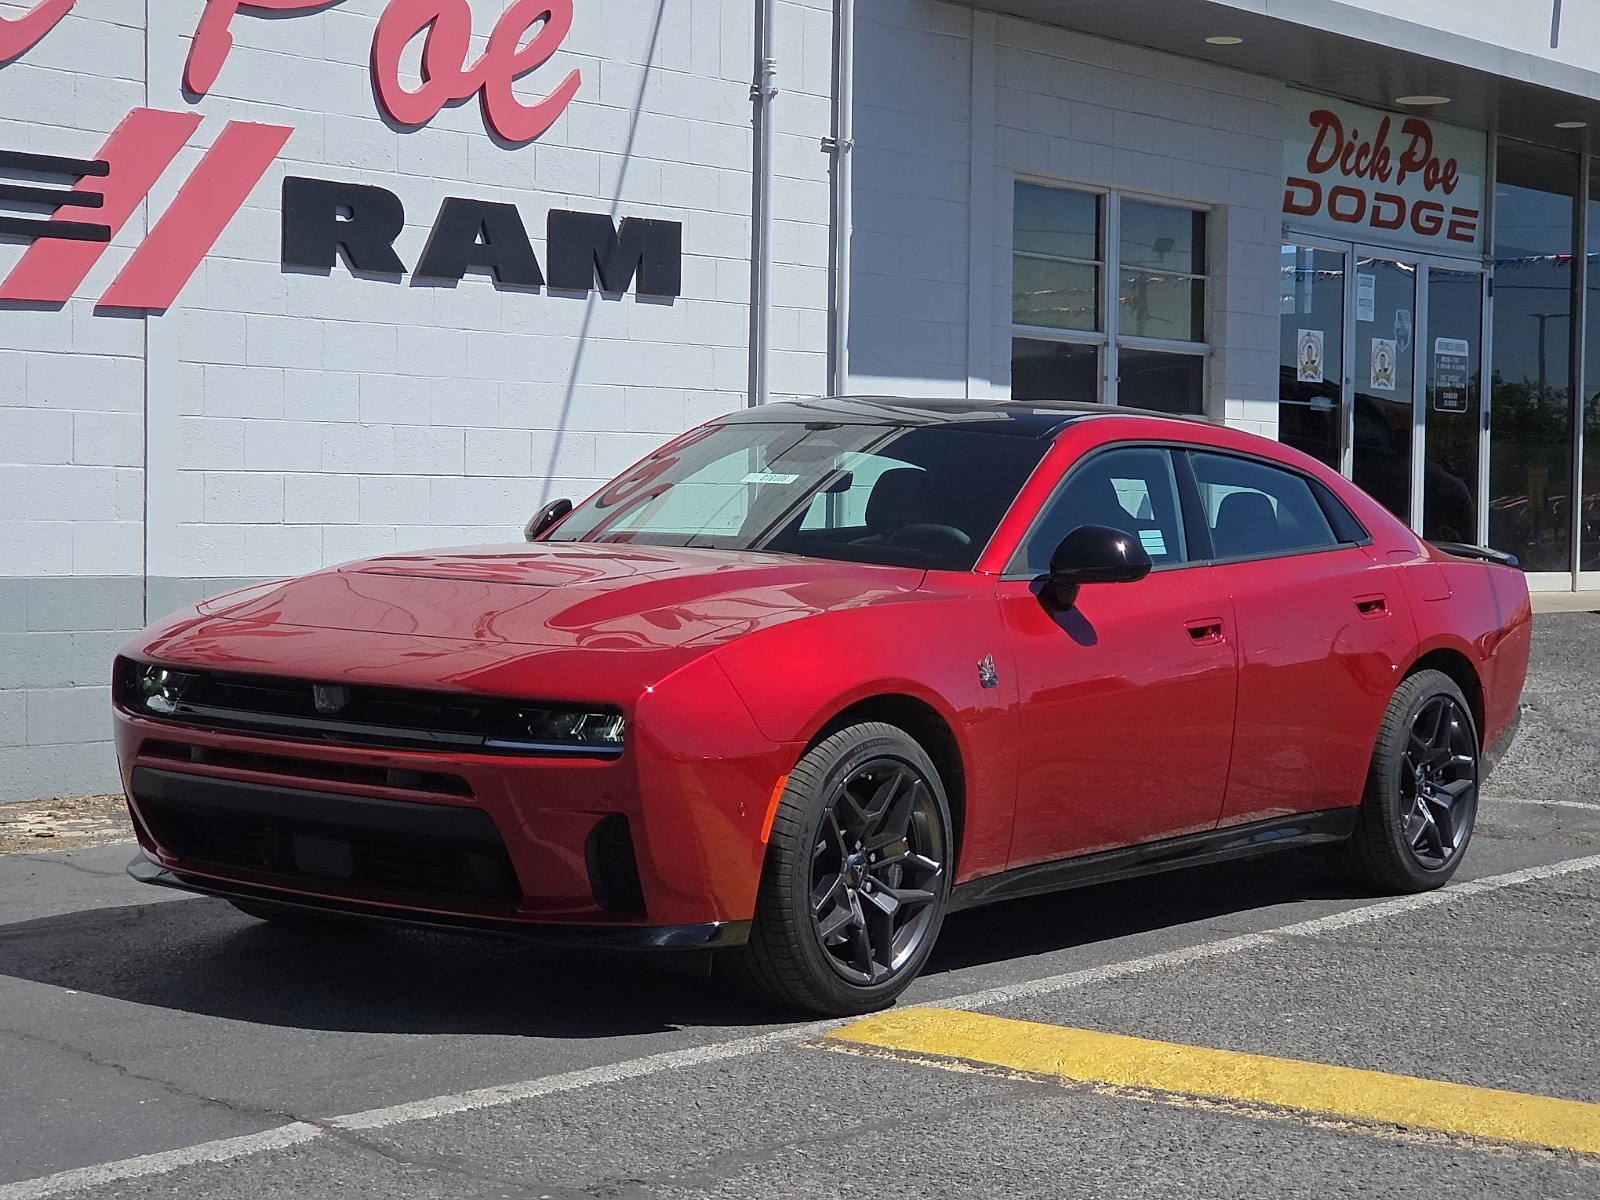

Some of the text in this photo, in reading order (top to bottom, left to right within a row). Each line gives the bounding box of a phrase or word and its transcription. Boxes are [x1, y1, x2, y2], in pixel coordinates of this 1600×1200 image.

[1307, 109, 1459, 195] Dick Poe
[281, 175, 682, 298] RAM
[1282, 176, 1479, 243] DODGE
